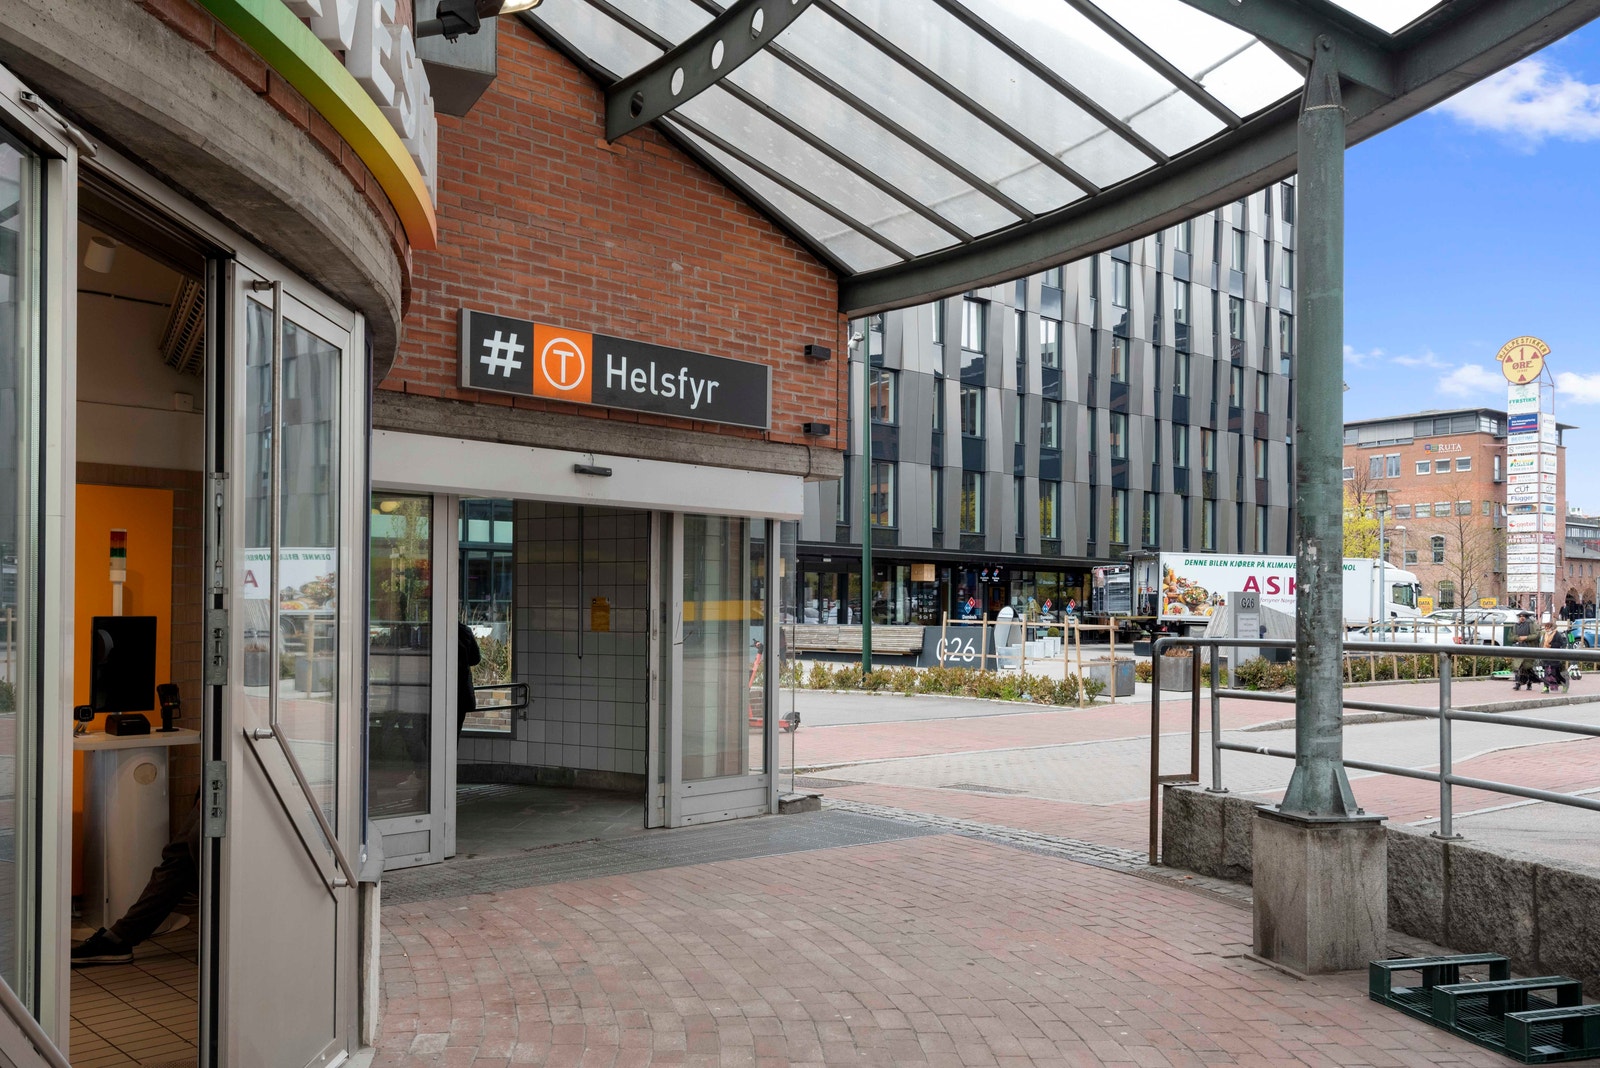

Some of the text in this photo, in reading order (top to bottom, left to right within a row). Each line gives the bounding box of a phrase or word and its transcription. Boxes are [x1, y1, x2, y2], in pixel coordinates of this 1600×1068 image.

[1520, 347, 1524, 360] 1
[1512, 361, 1534, 370] ØRE
[606, 353, 719, 410] Helsfyr
[1438, 443, 1462, 452] RUTA
[1230, 560, 1255, 568] KJØRER
[1257, 560, 1265, 568] PÅ
[1241, 597, 1255, 608] G26
[936, 637, 975, 662] G26
